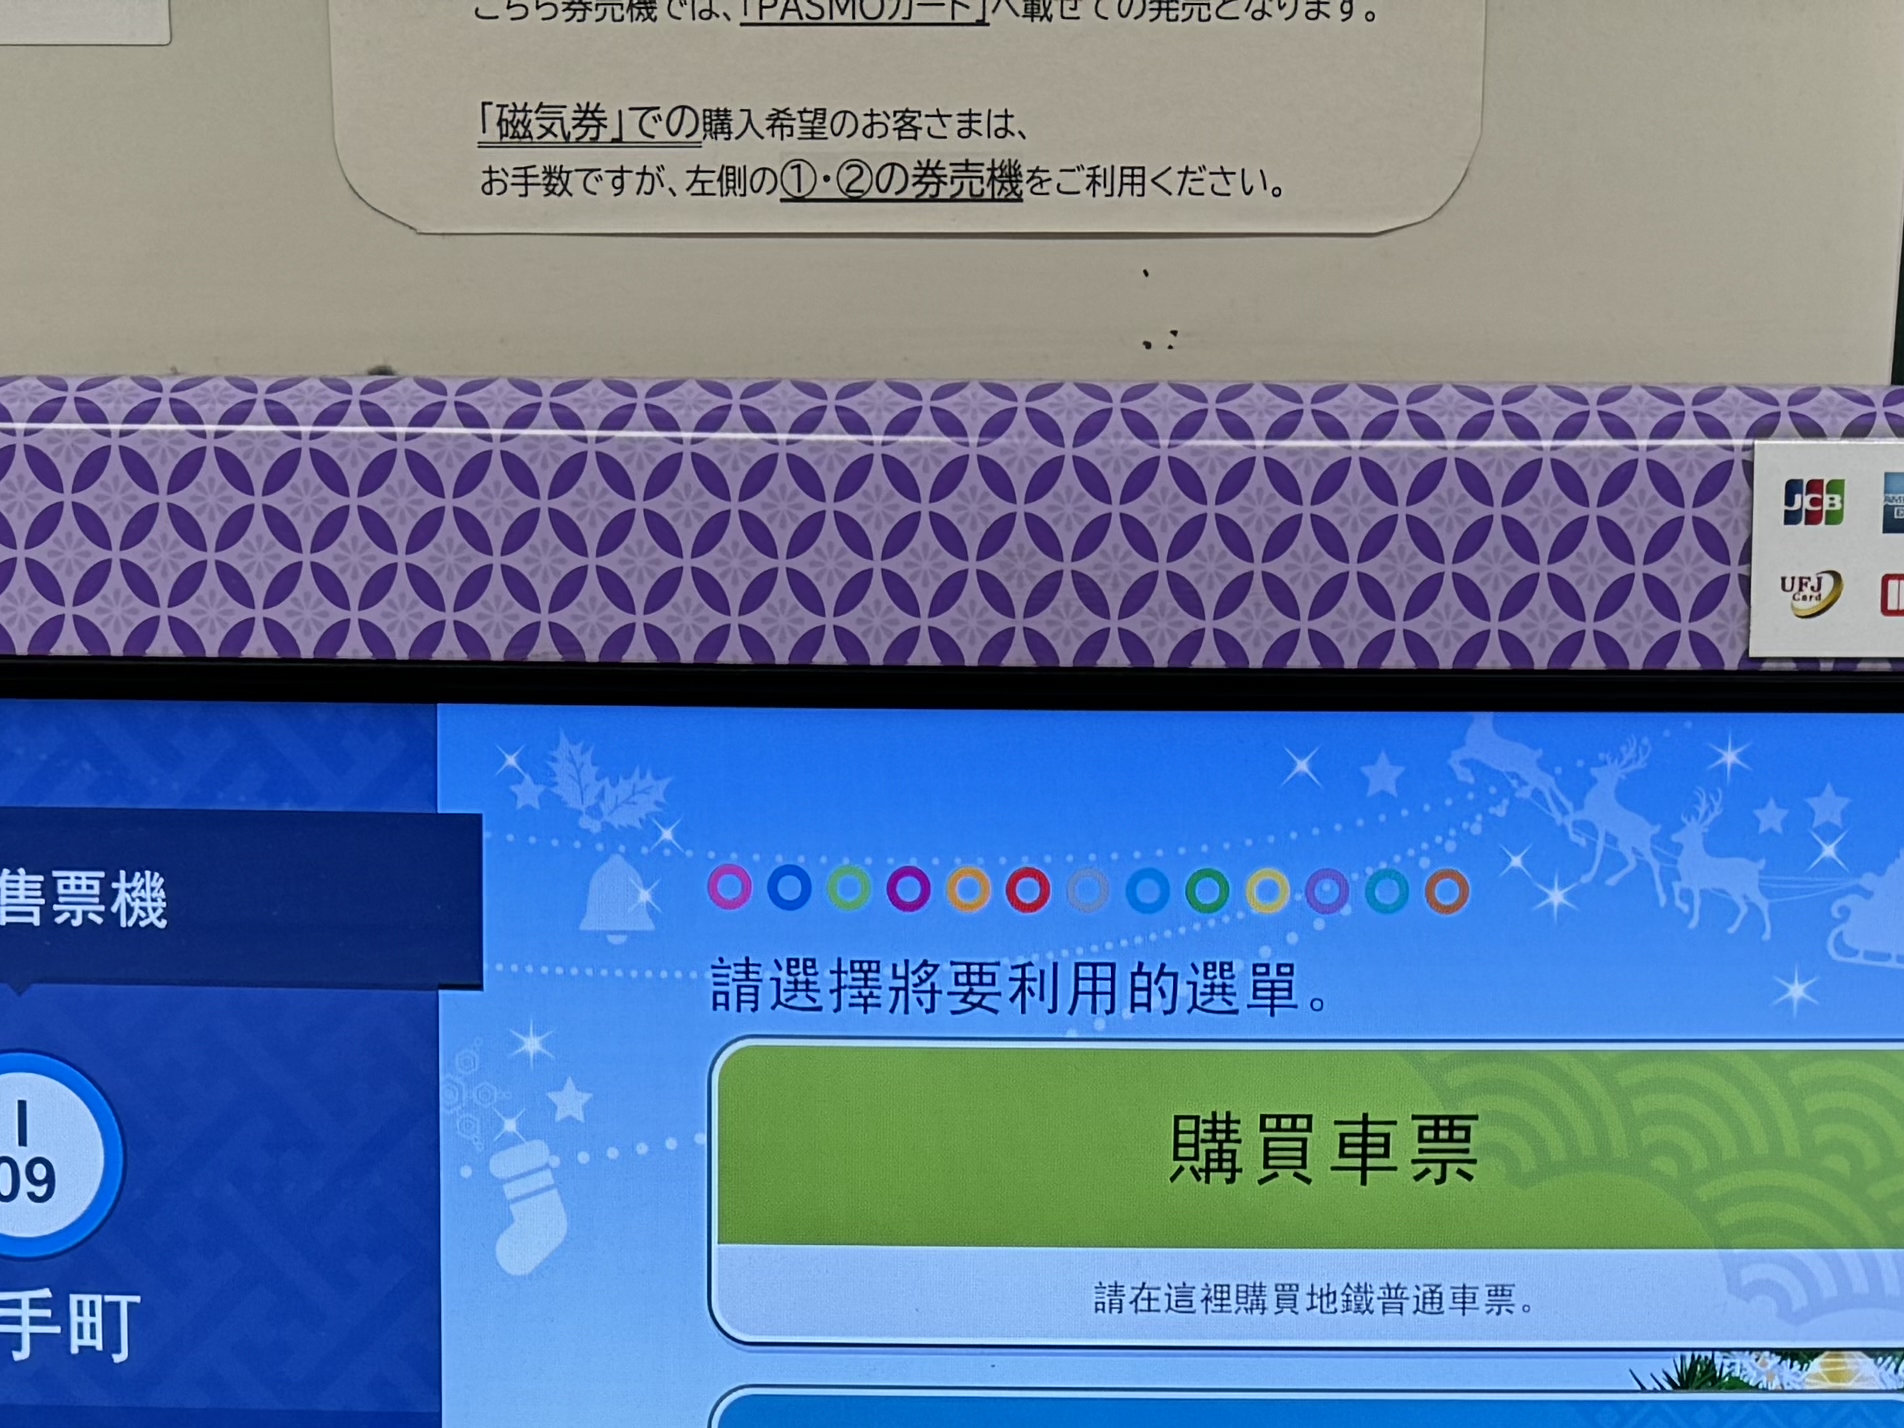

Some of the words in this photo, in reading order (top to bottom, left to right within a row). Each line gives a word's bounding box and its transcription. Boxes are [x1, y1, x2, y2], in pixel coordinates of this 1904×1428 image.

[480, 101, 1027, 142] 「磁気券」での購入希望のお客さまは、
[1784, 493, 1842, 511] JCB
[1781, 576, 1823, 593] UFJ
[1792, 592, 1822, 602] Card
[710, 956, 1327, 1018] 請選擇將要利用的選單。
[1170, 1110, 1480, 1187] 購買車票
[1094, 1281, 1534, 1319] 請在這裡購買地鐵普通車票。
